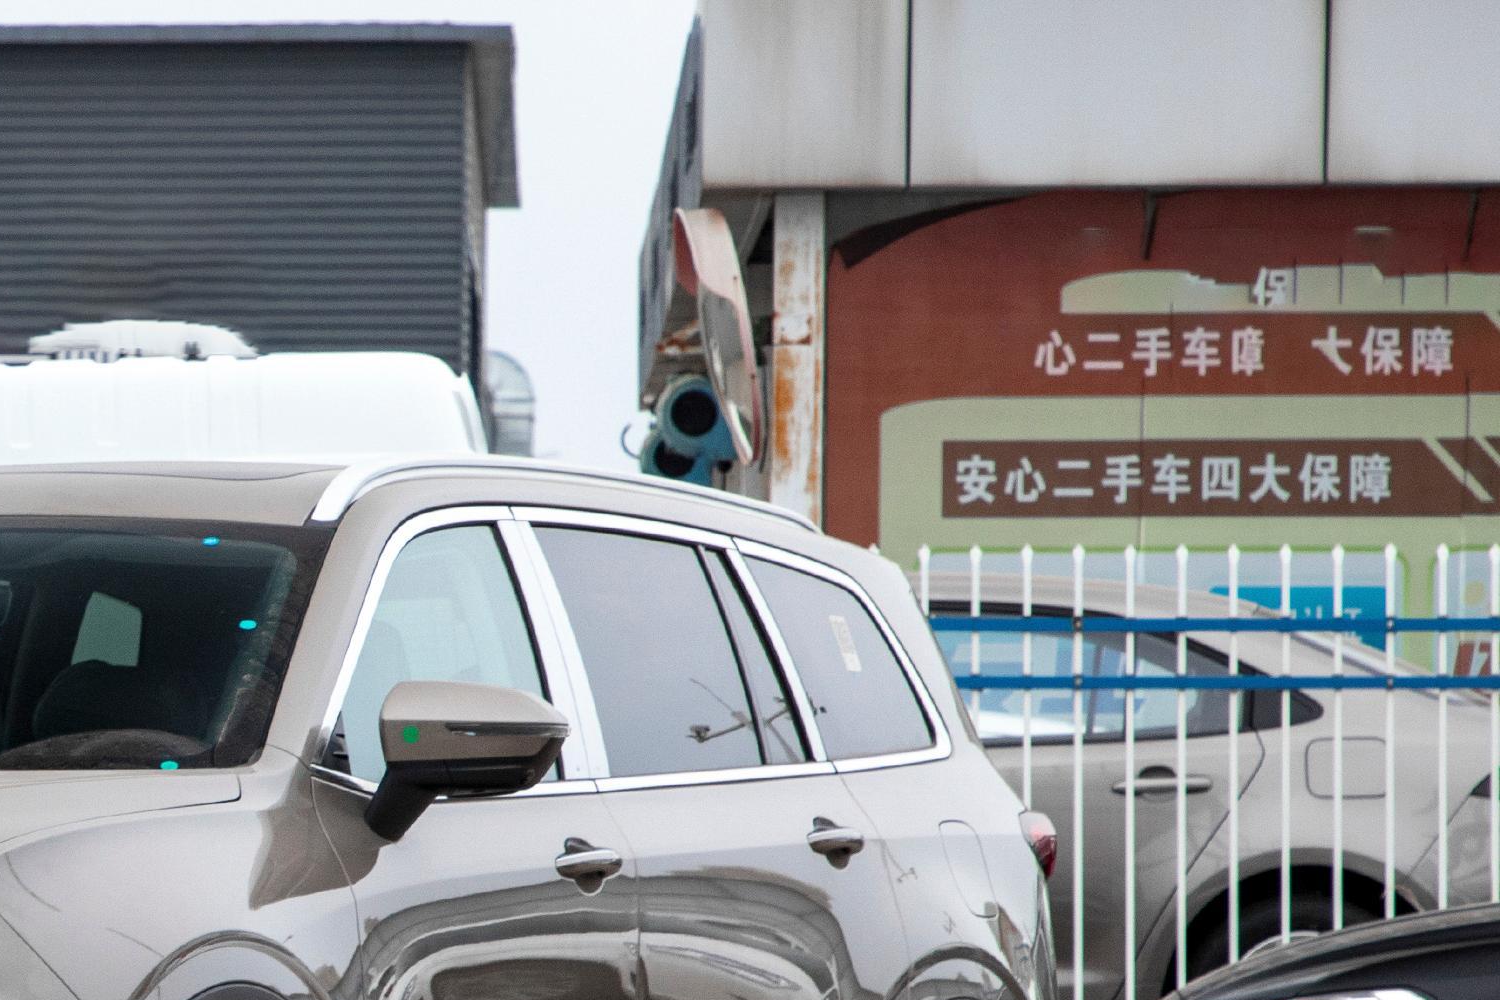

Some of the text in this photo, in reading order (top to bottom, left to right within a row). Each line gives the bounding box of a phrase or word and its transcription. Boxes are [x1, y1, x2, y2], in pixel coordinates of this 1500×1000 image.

[955, 453, 1392, 504] 安心二手车四大保障
